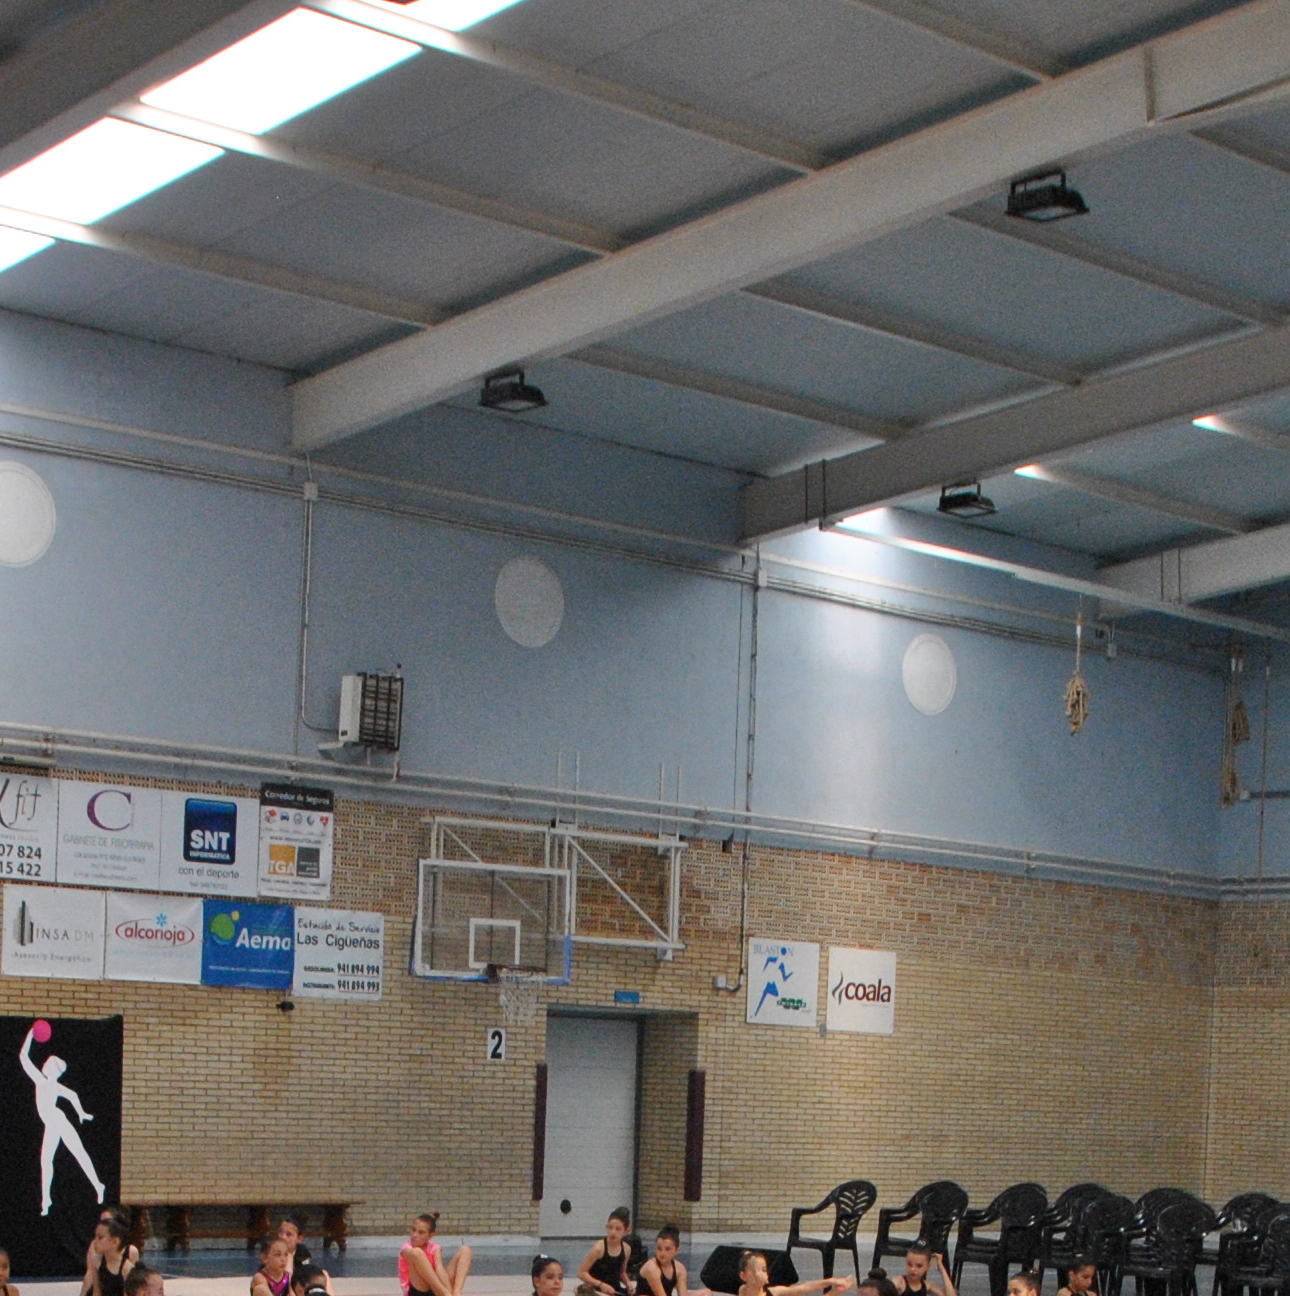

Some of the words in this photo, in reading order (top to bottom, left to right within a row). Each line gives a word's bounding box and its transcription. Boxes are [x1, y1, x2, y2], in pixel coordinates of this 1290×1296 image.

[190, 829, 230, 851] SNT
[17, 845, 42, 859] 824
[17, 862, 41, 877] 422
[178, 867, 194, 876] con
[196, 867, 204, 876] el
[206, 868, 240, 879] deporte
[36, 927, 70, 940] INSA
[124, 921, 185, 946] alcorioja
[335, 921, 346, 931] de
[349, 921, 381, 934] Servicio
[235, 926, 291, 951] Aema
[297, 932, 319, 946] Las
[337, 962, 350, 974] 941
[351, 963, 365, 975] 894
[337, 979, 350, 989] 941
[351, 980, 365, 991] 894
[845, 978, 892, 1003] coala
[491, 1030, 502, 1060] 2
